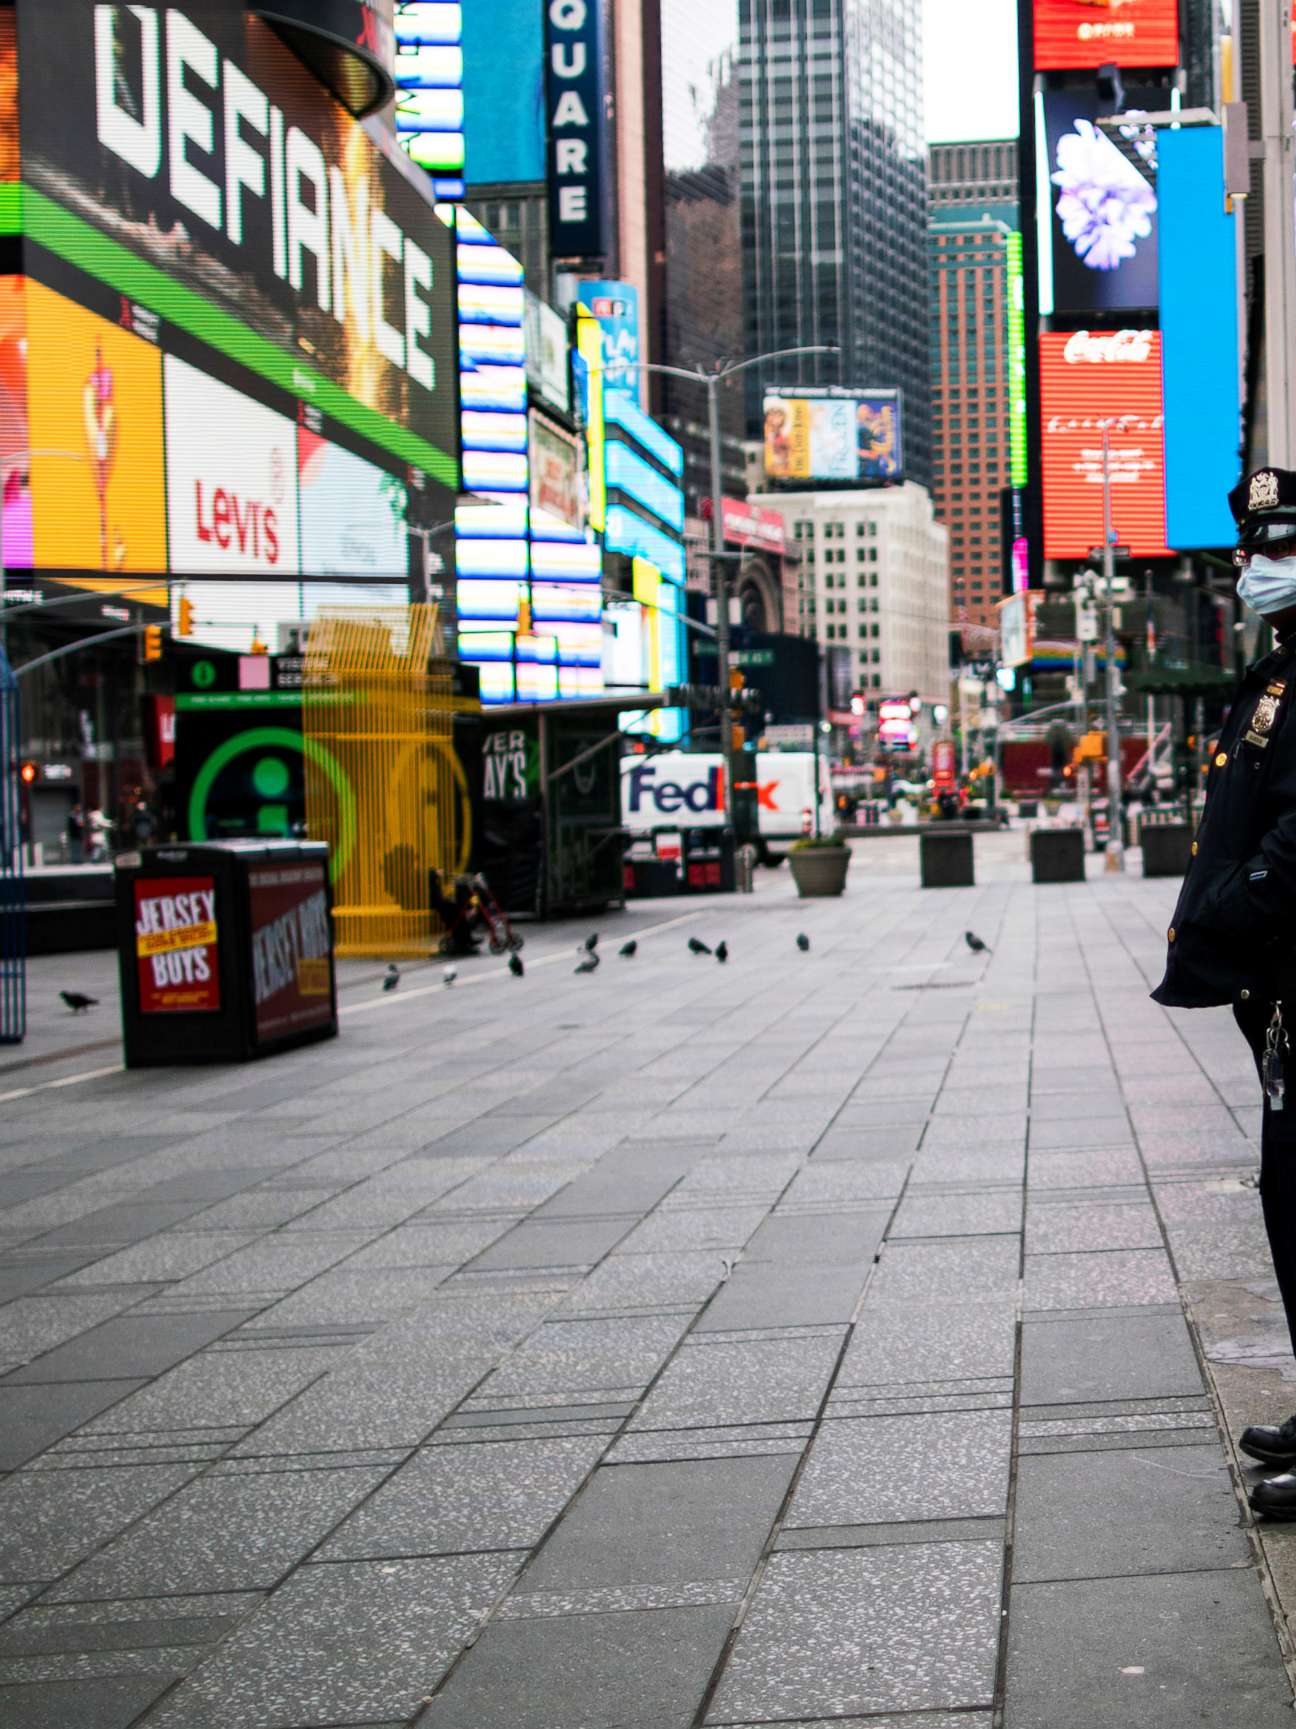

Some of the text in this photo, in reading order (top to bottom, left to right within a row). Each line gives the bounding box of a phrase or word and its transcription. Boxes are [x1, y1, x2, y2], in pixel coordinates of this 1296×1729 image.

[549, 0, 590, 223] QUARE
[95, 4, 436, 392] DEFIANCE
[136, 889, 216, 935] JERSEY
[152, 946, 211, 988] BOYS
